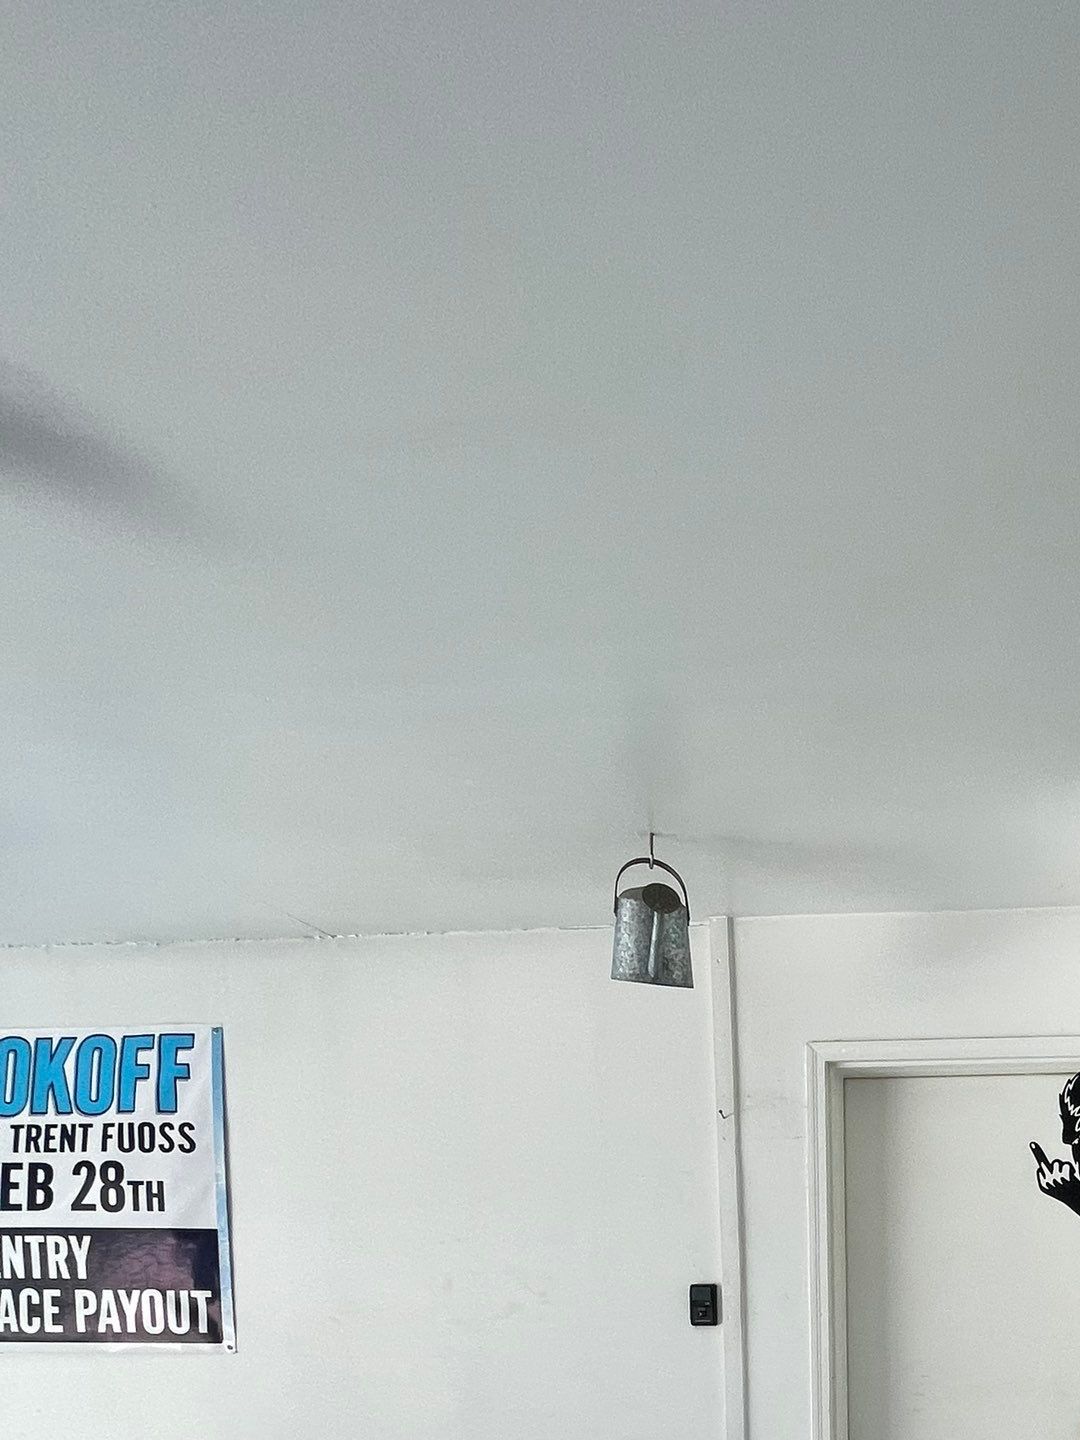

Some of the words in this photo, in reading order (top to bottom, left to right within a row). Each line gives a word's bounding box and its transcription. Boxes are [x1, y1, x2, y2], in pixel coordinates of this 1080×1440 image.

[10, 1122, 94, 1154] TRENT
[101, 1121, 197, 1154] FUOSS
[70, 1160, 166, 1213] 28TH
[0, 1234, 92, 1280] NTRY
[75, 1289, 213, 1335] PAYOUT
